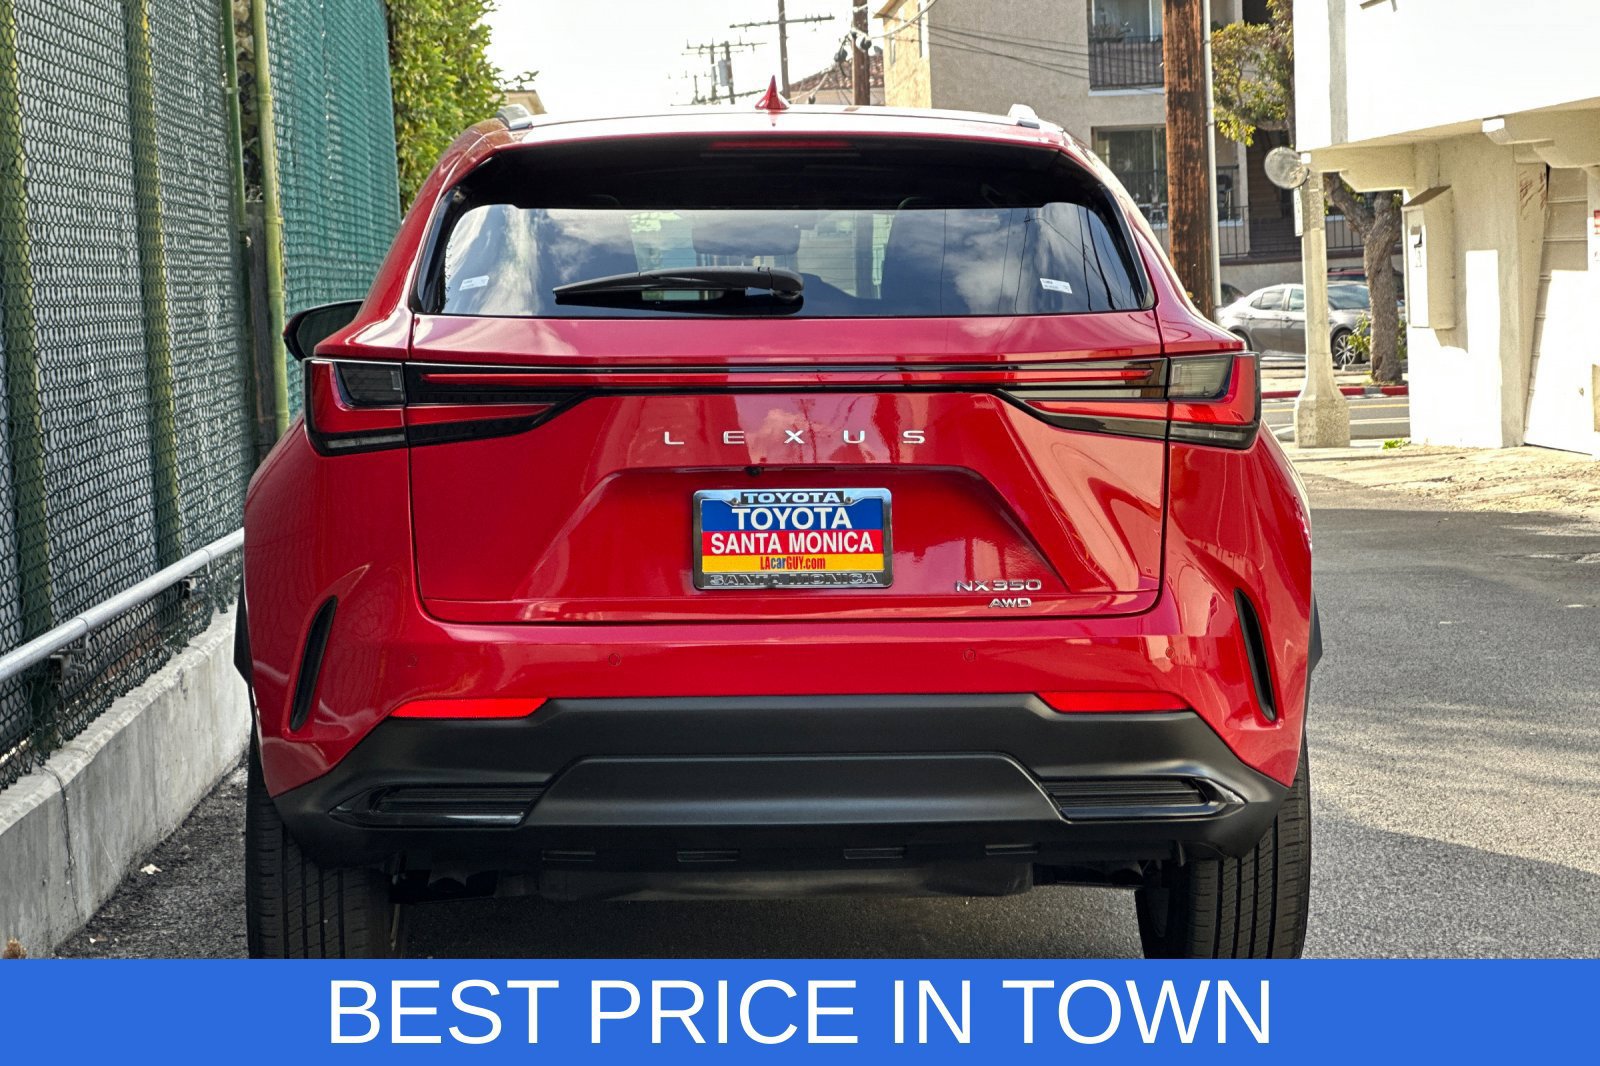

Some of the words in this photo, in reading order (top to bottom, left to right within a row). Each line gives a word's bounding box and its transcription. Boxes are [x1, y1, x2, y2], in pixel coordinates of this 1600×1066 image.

[664, 430, 925, 445] LEXUS
[743, 492, 840, 504] TOYOTA
[731, 507, 853, 530] TOYOTA
[711, 532, 783, 554] SANTA
[789, 531, 874, 554] MONICA
[759, 556, 826, 570] LAcarGUY.com
[709, 574, 783, 586] SANTA
[789, 573, 878, 585] MONICA
[988, 598, 1032, 608] AWD
